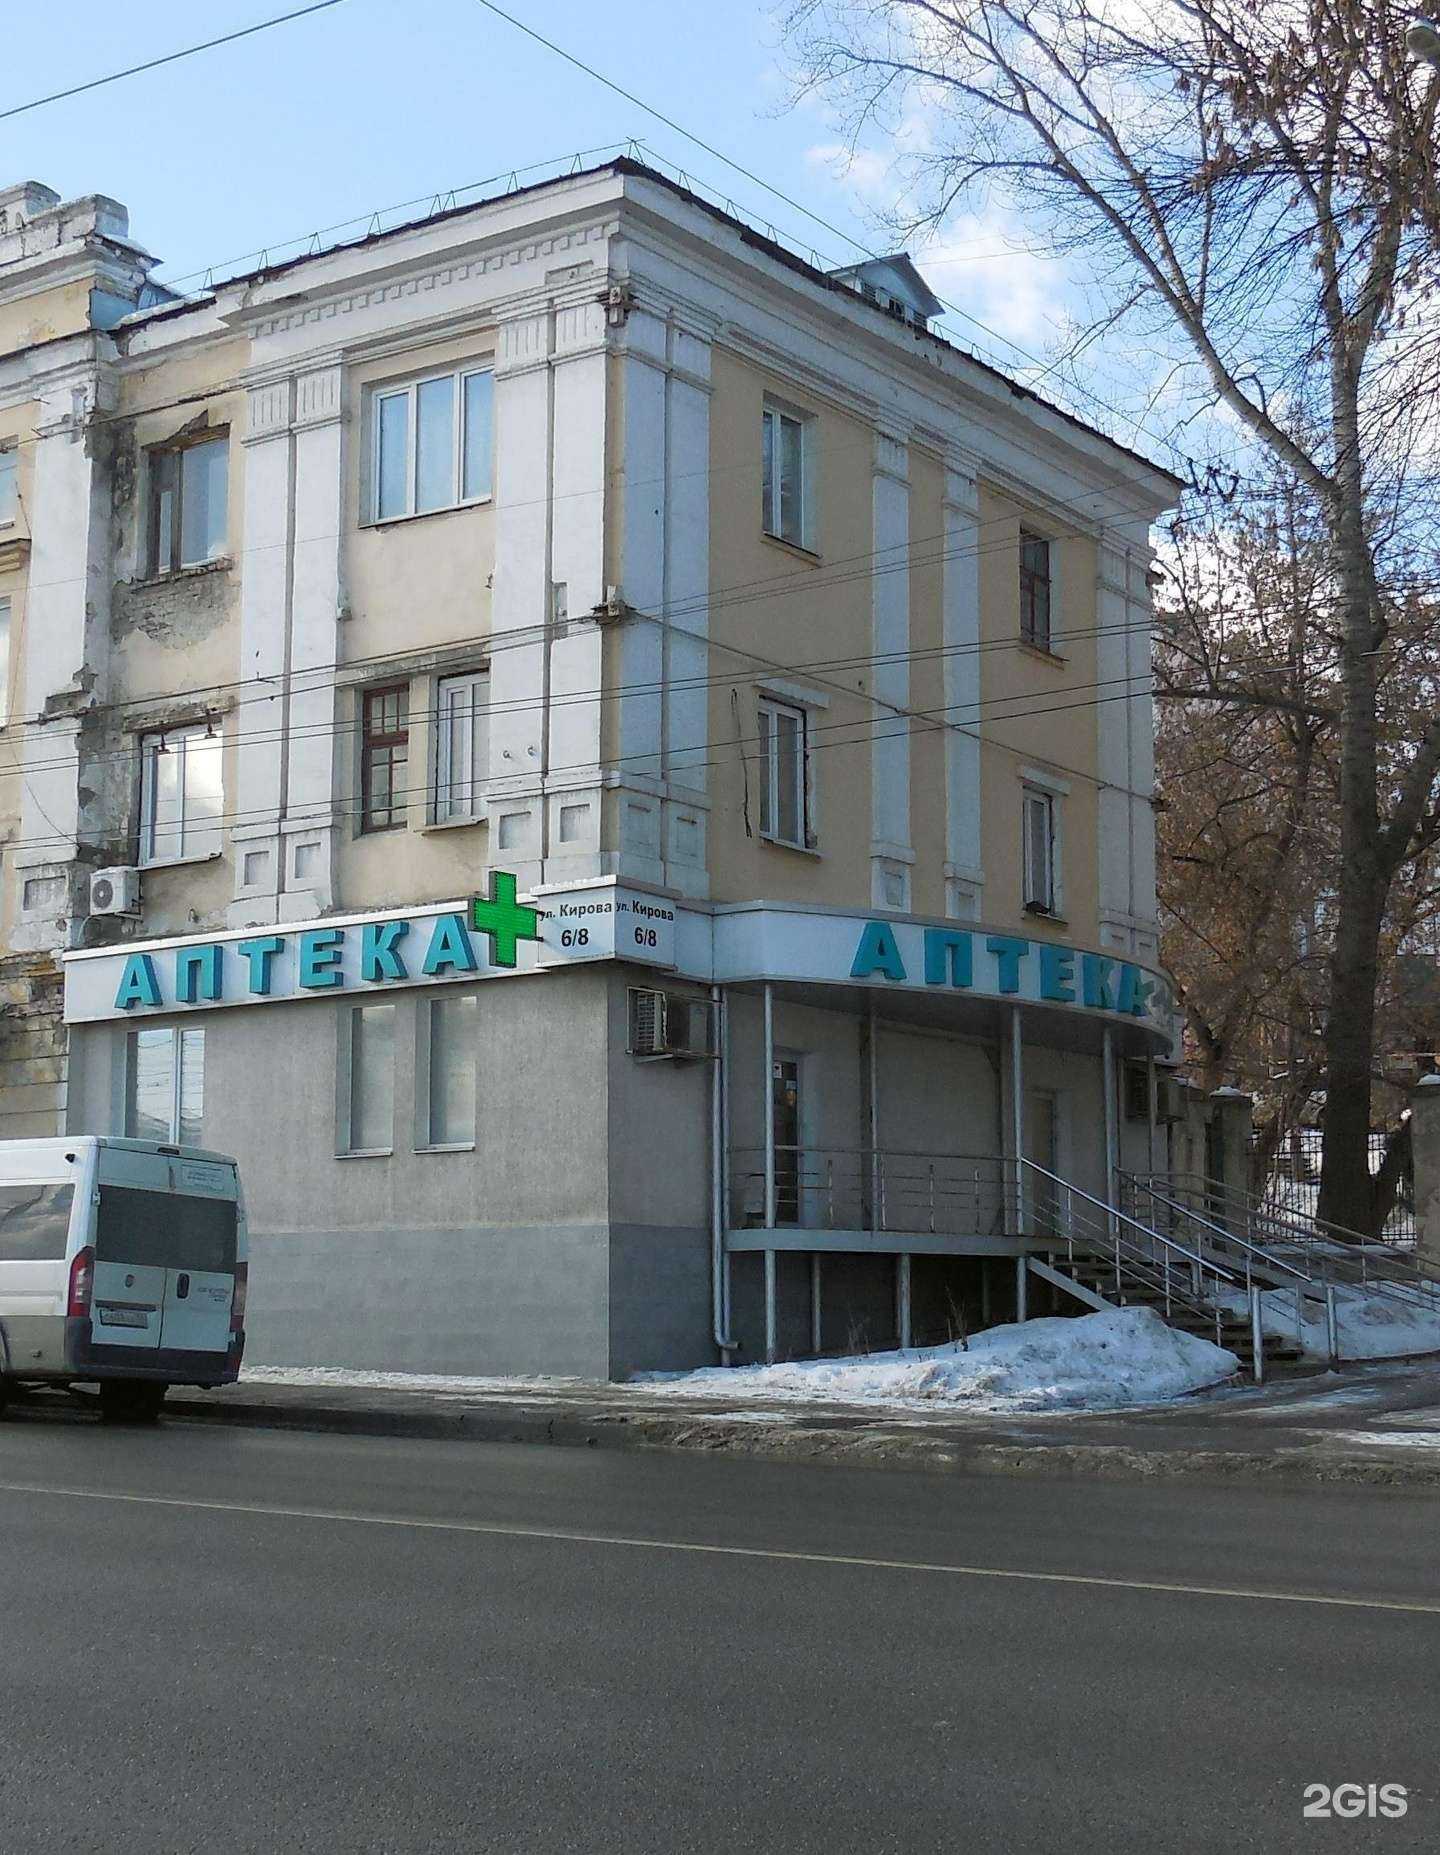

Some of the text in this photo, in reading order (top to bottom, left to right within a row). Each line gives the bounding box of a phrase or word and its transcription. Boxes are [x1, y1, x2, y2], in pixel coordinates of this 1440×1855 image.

[559, 902, 612, 918] Кирова
[616, 900, 674, 921] ул. Кирова
[561, 928, 589, 947] 6/8
[634, 926, 657, 947] 6/8
[114, 914, 479, 1010] АПТЕКА
[849, 921, 1155, 1017] АПТЕКА
